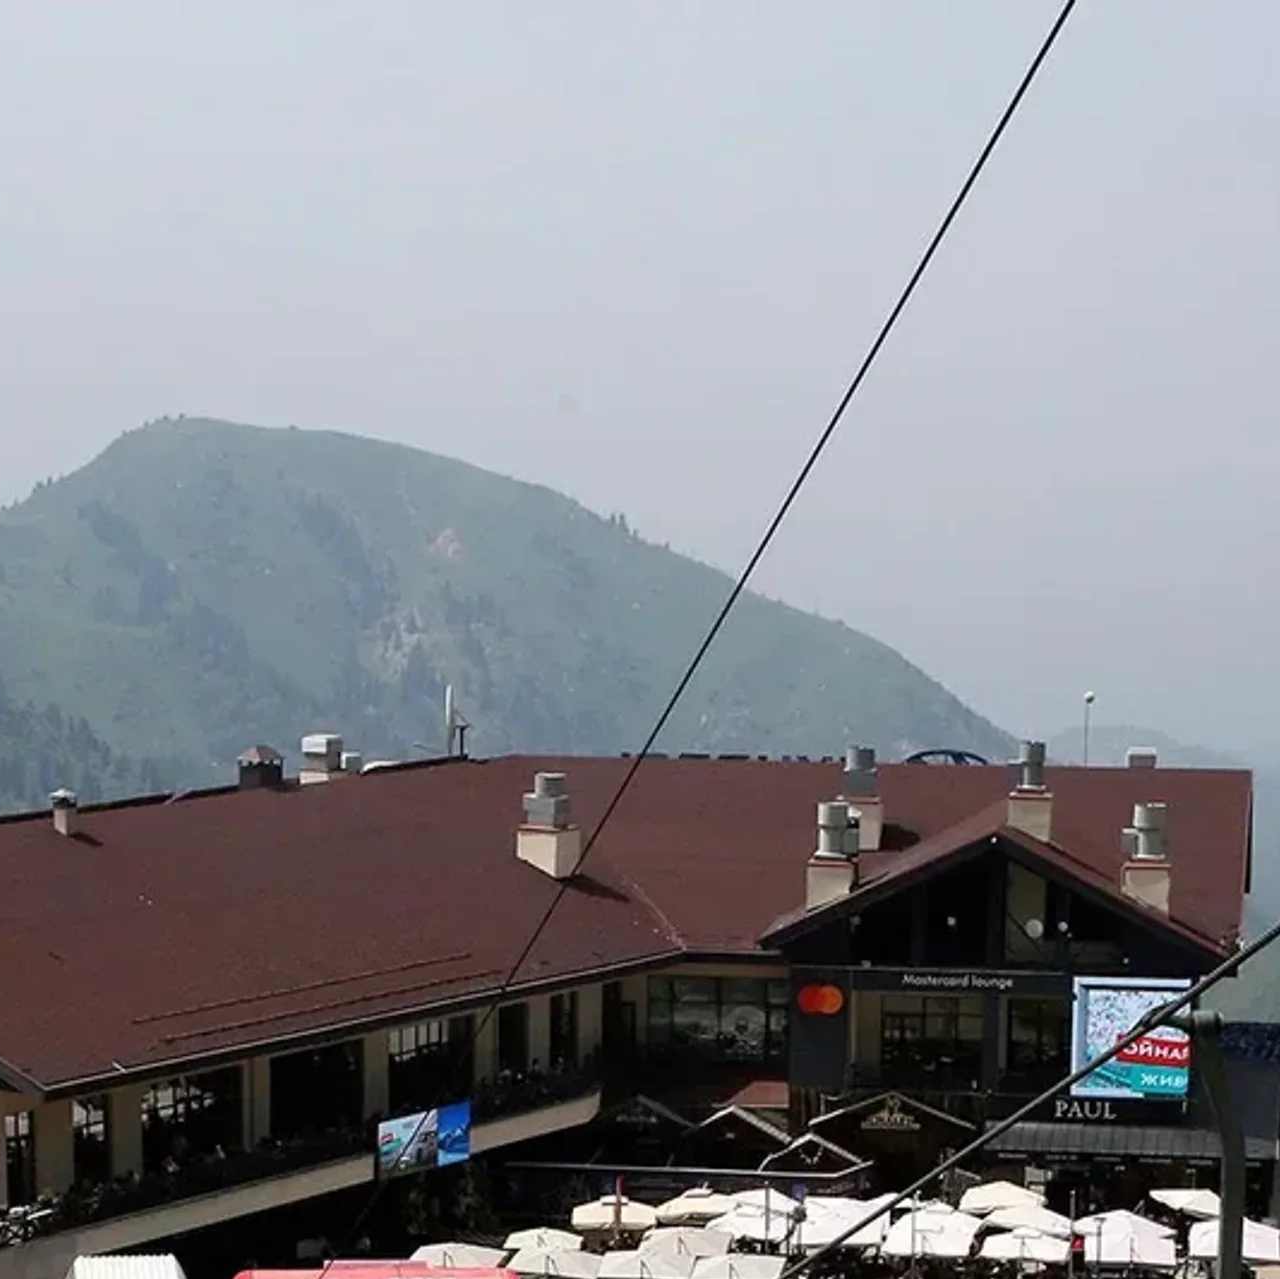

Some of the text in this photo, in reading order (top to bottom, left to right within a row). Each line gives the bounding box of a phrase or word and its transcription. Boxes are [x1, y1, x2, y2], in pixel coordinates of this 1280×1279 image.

[901, 974, 1013, 990] Mastercard lounge
[1055, 1100, 1117, 1120] PAUL
